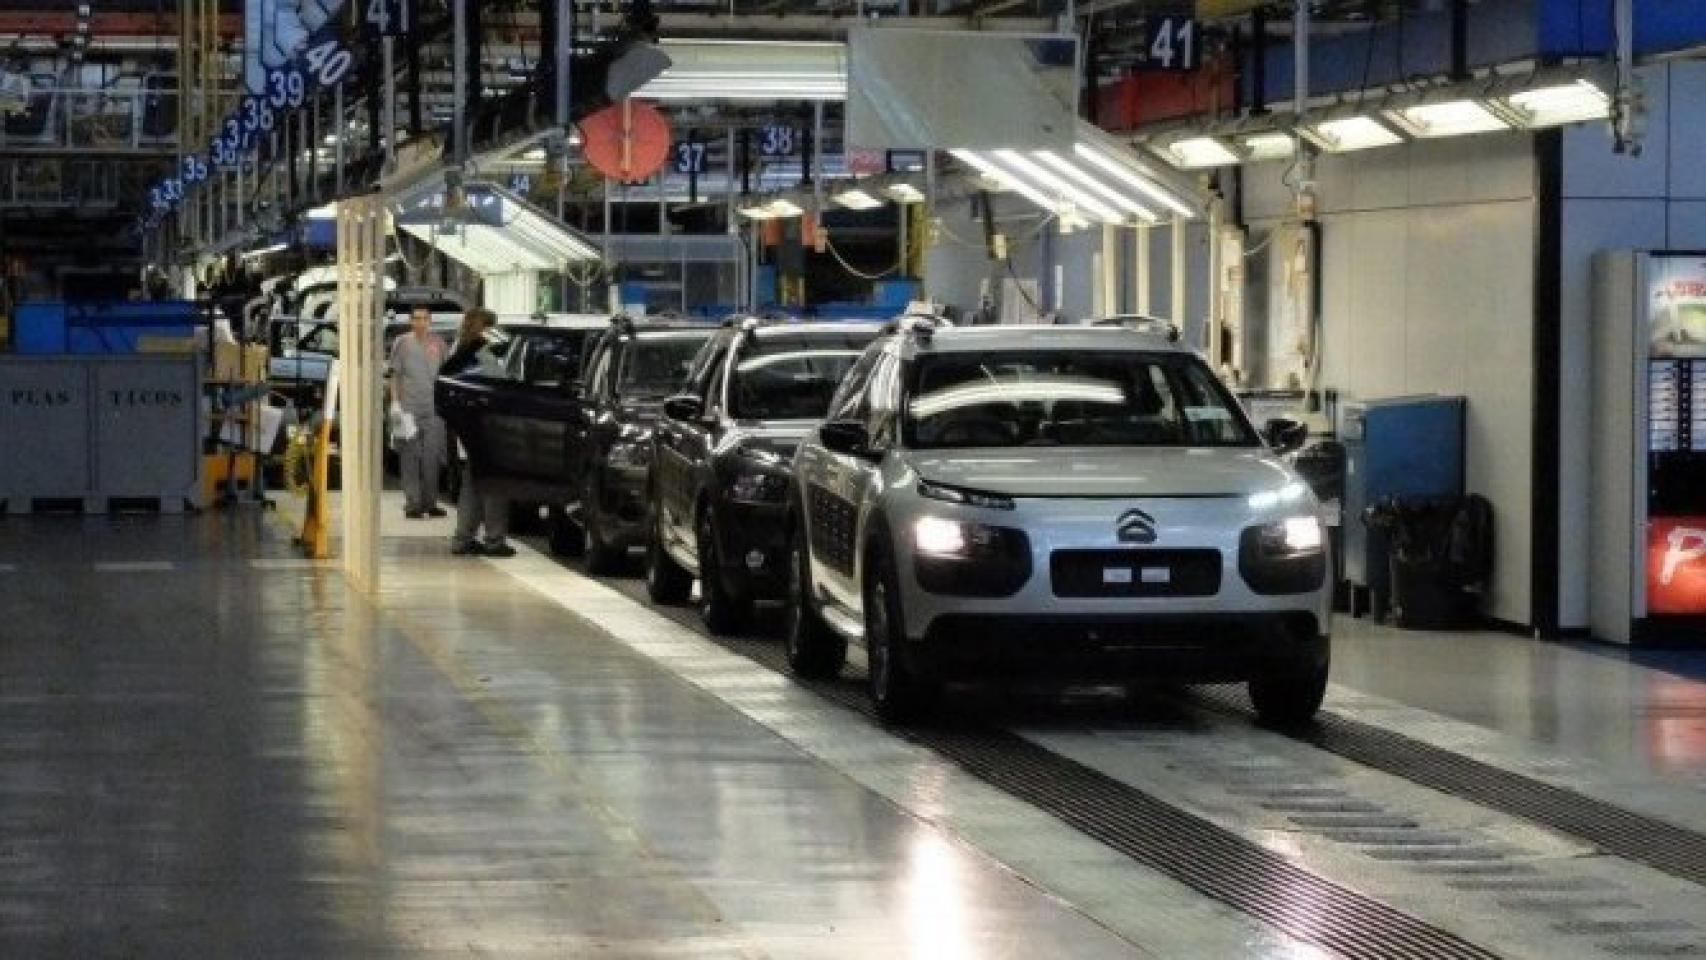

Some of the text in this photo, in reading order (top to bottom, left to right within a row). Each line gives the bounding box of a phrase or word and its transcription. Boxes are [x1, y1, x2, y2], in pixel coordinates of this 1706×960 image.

[1151, 18, 1191, 69] 41
[306, 40, 351, 84] 40
[270, 71, 304, 107] 39
[763, 124, 793, 154] 38
[679, 143, 704, 172] 37
[11, 389, 183, 408] PLAS TICOS
